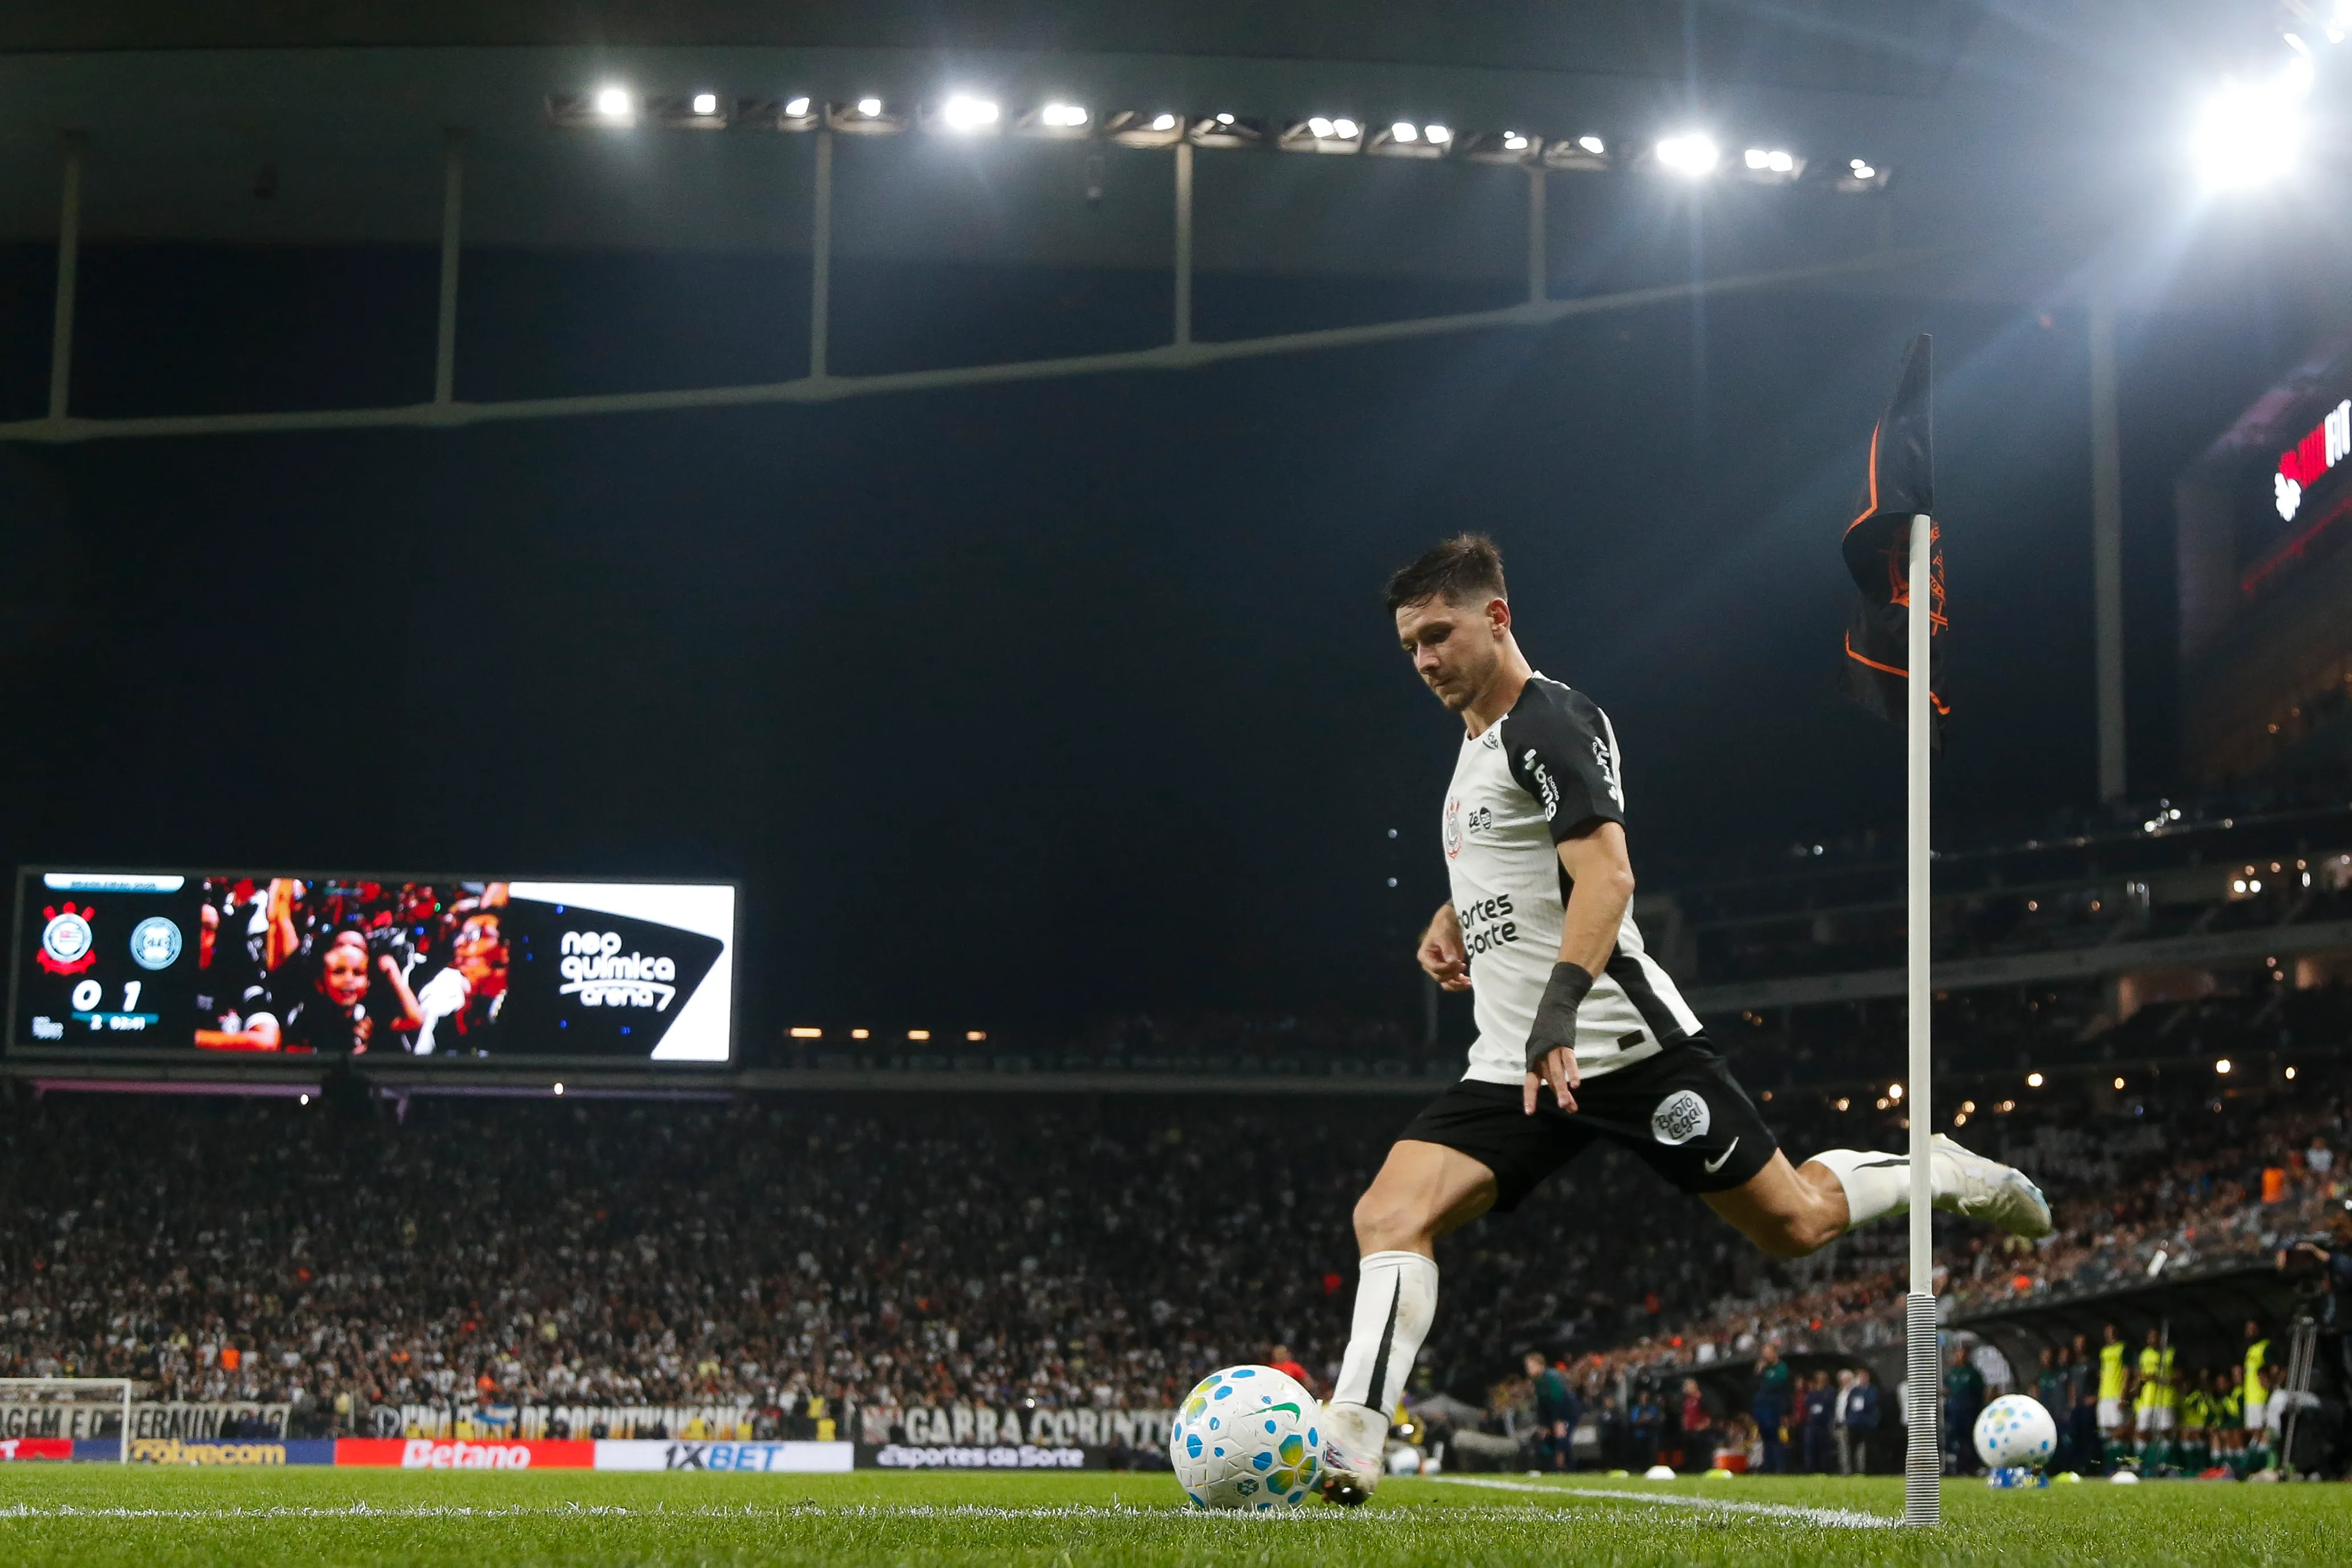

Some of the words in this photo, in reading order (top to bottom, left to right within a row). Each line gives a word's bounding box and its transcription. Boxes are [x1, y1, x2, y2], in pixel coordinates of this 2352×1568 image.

[1534, 763, 1557, 822] bmg
[1547, 775, 1560, 801] banco
[1458, 893, 1514, 930] ortes
[560, 931, 622, 956] neo
[72, 979, 102, 1012] 0
[121, 980, 142, 1013] 1
[580, 985, 654, 1008] arena
[1655, 1094, 1693, 1130] Broto
[1668, 1103, 1703, 1140] Legal
[401, 1438, 532, 1469] Betano
[666, 1445, 784, 1471] 1XBET
